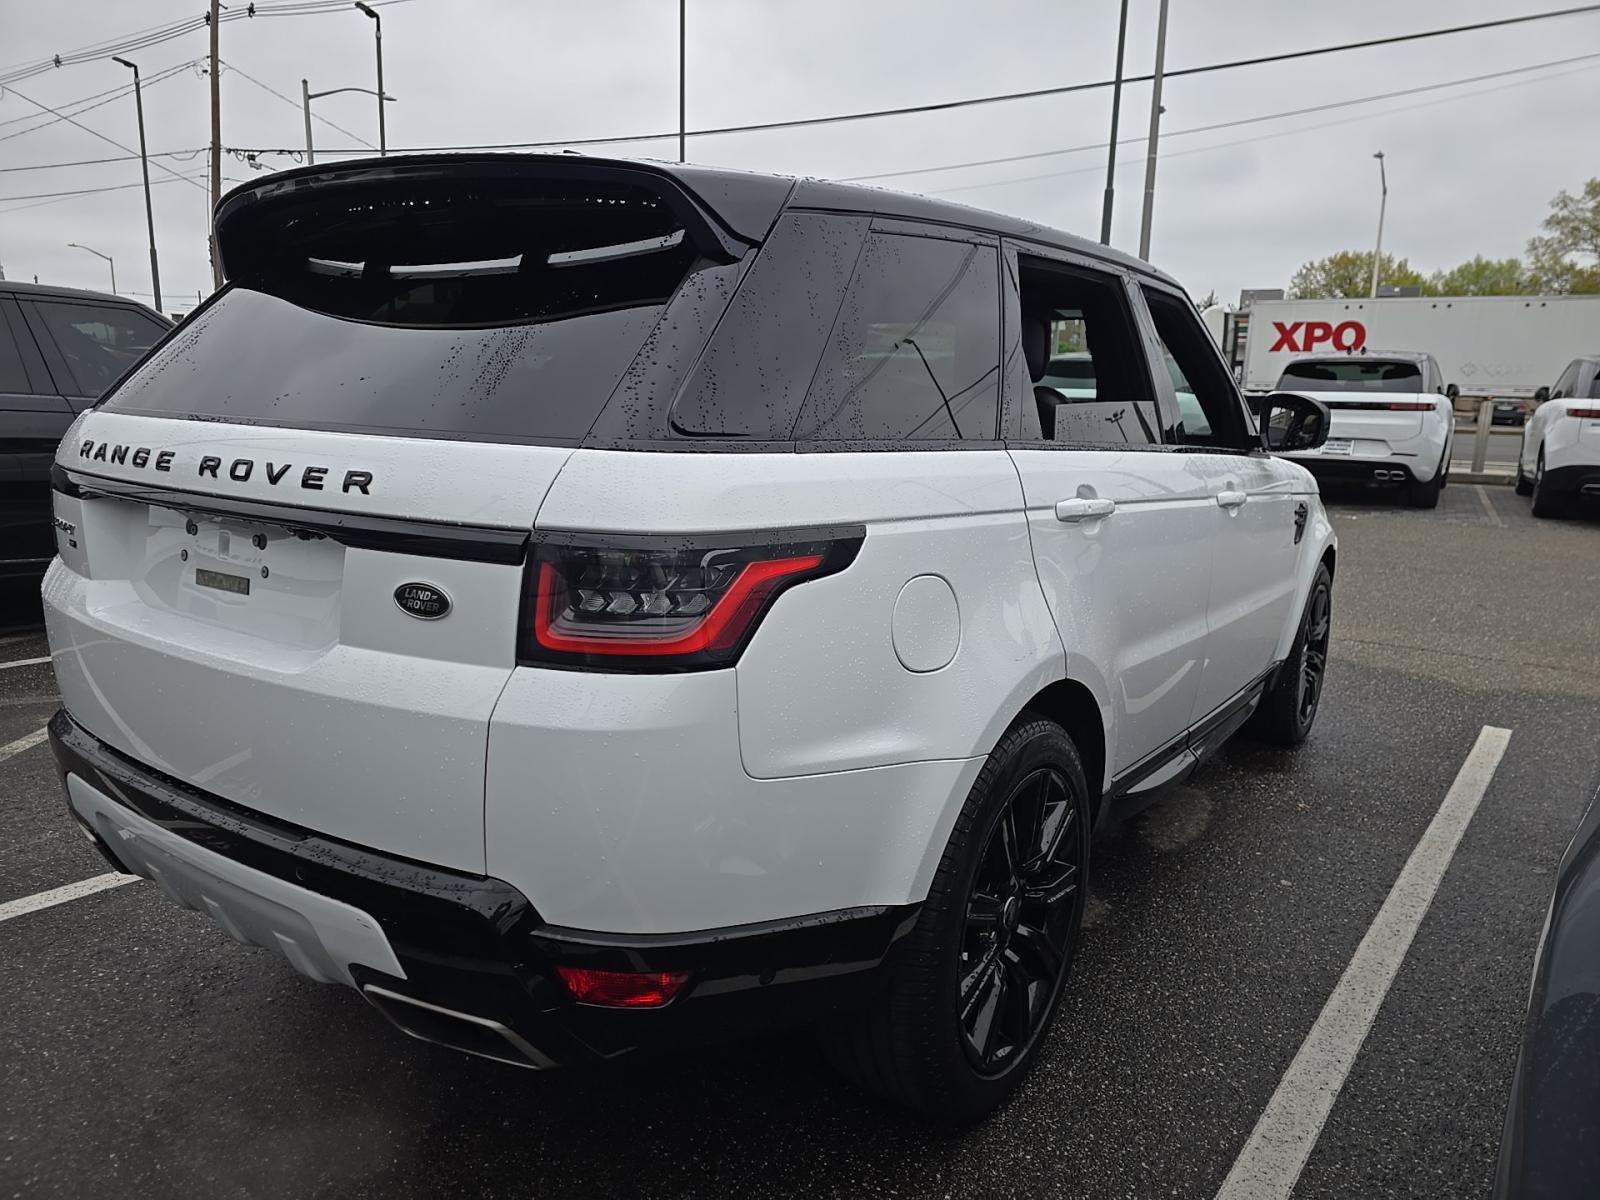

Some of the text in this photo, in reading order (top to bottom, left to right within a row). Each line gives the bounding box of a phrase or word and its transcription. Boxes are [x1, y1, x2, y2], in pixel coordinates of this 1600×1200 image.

[1269, 320, 1366, 352] XPO
[79, 440, 374, 495] RANGE ROVER
[404, 588, 431, 601] LAND
[407, 599, 440, 612] ROVER
